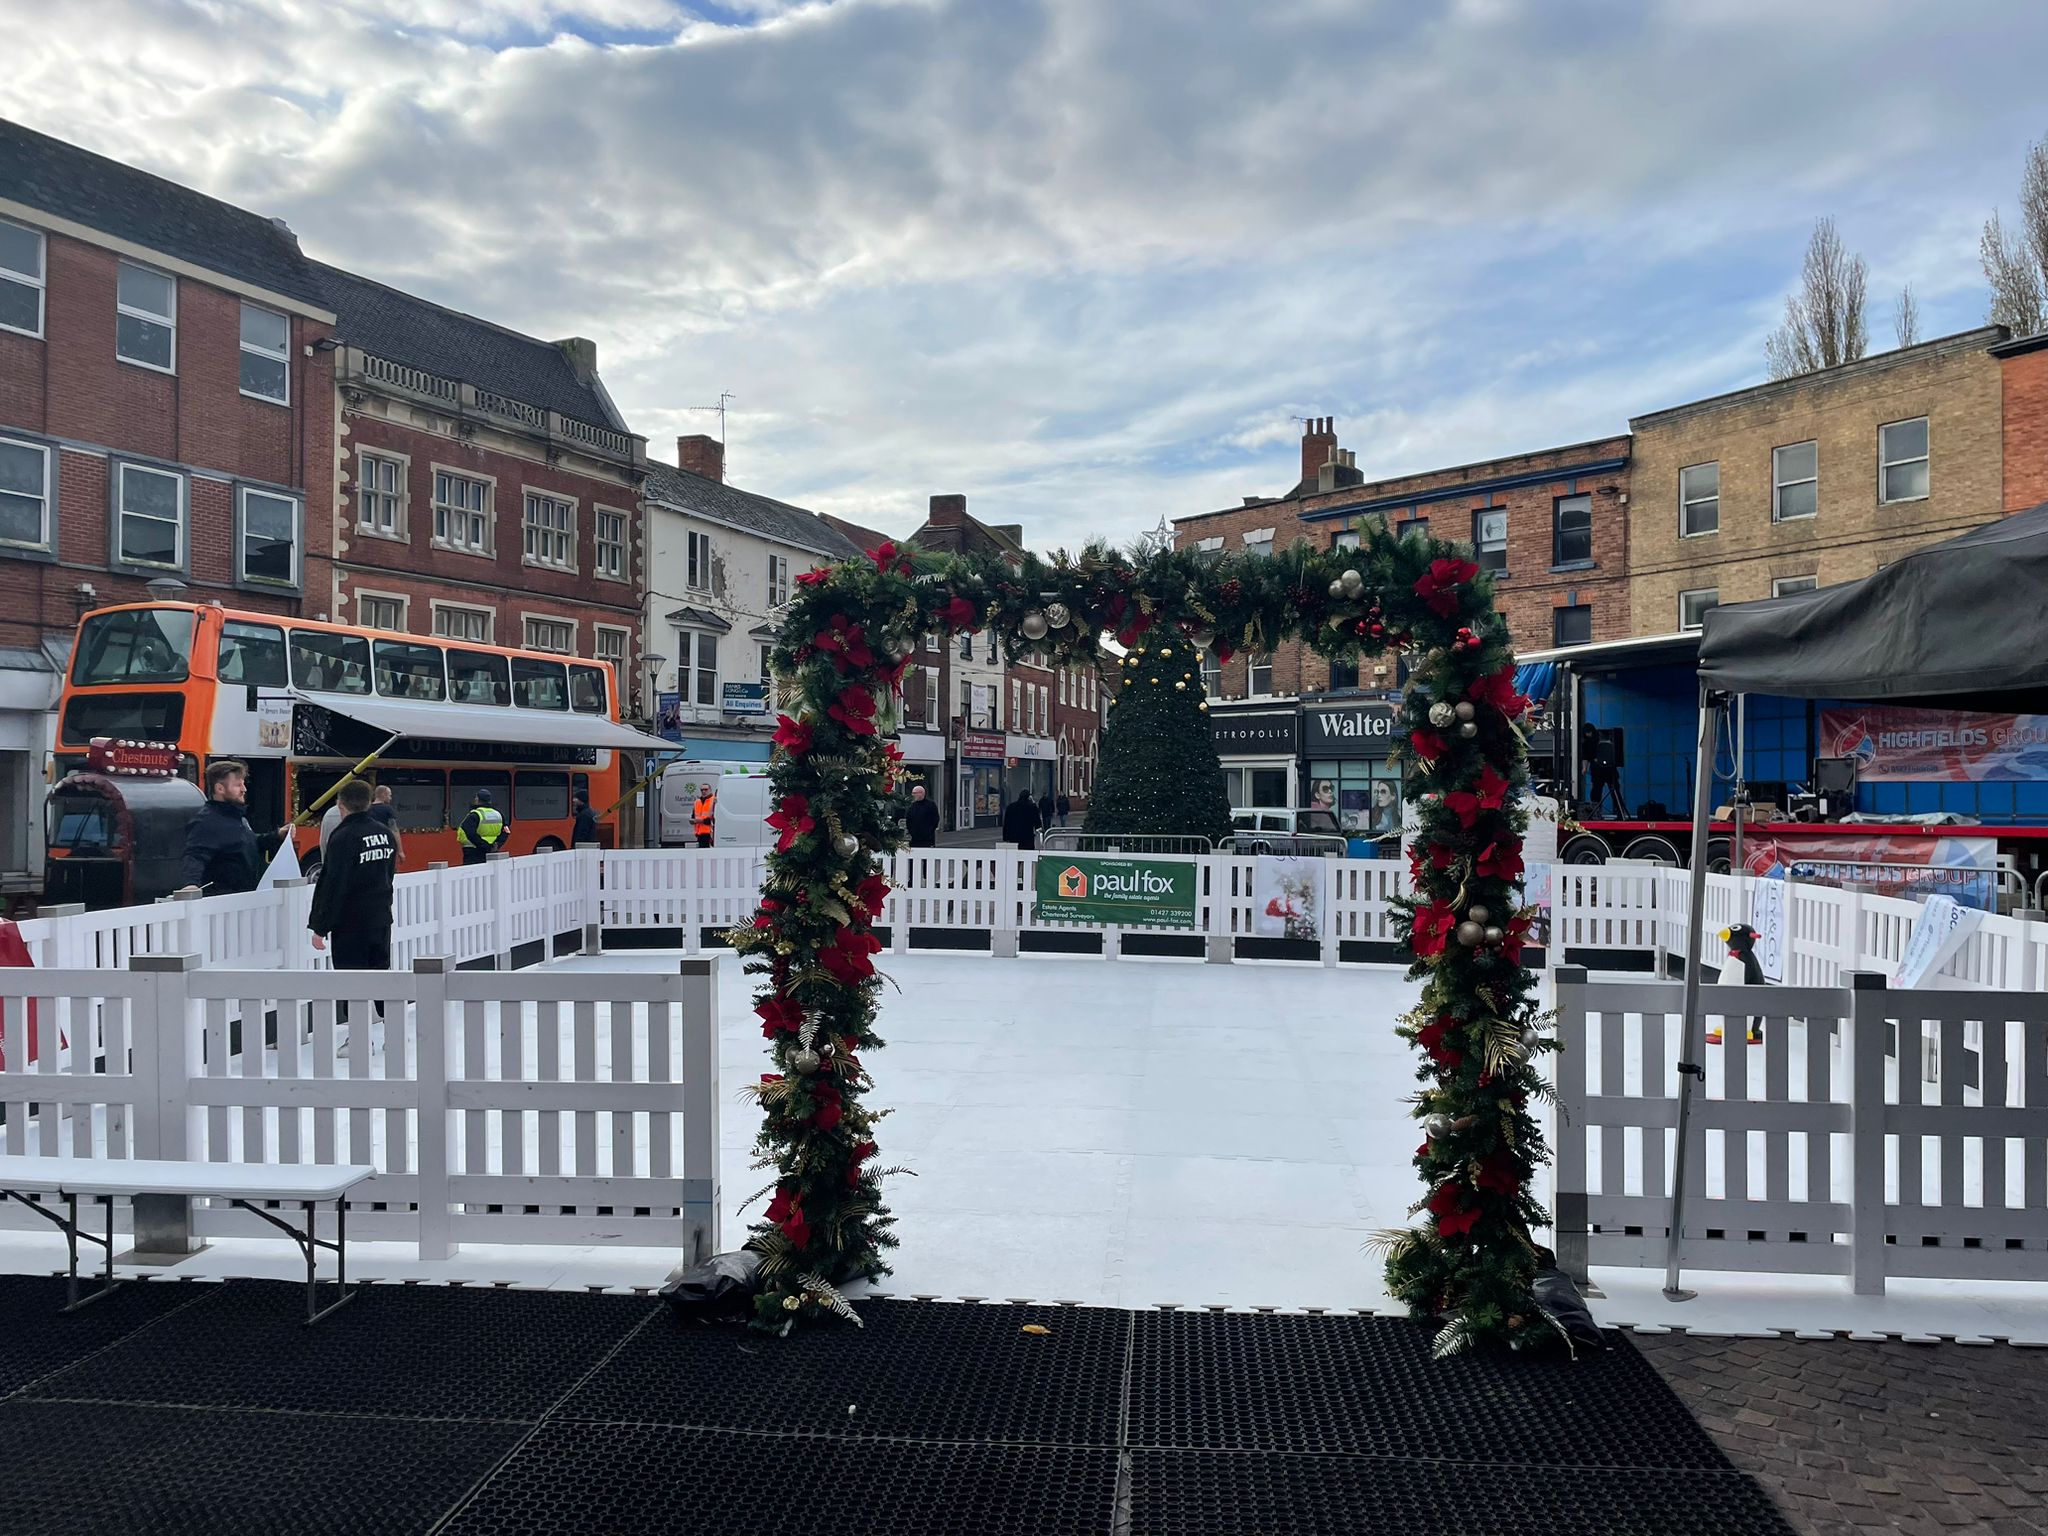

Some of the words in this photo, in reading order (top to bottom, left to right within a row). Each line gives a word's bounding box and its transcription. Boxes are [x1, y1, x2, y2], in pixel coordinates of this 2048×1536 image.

[725, 700, 734, 708] All
[734, 700, 762, 709] Enquiries
[1215, 729, 1289, 739] ETROPOLIS
[1878, 729, 1988, 749] HIGHFIELDS
[1991, 726, 2048, 746] GROU
[112, 748, 169, 766] Chestnuts
[362, 833, 389, 847] TEAM
[1111, 893, 1128, 901] family
[1041, 903, 1058, 911] Estate
[1069, 912, 1095, 920] Surveyors
